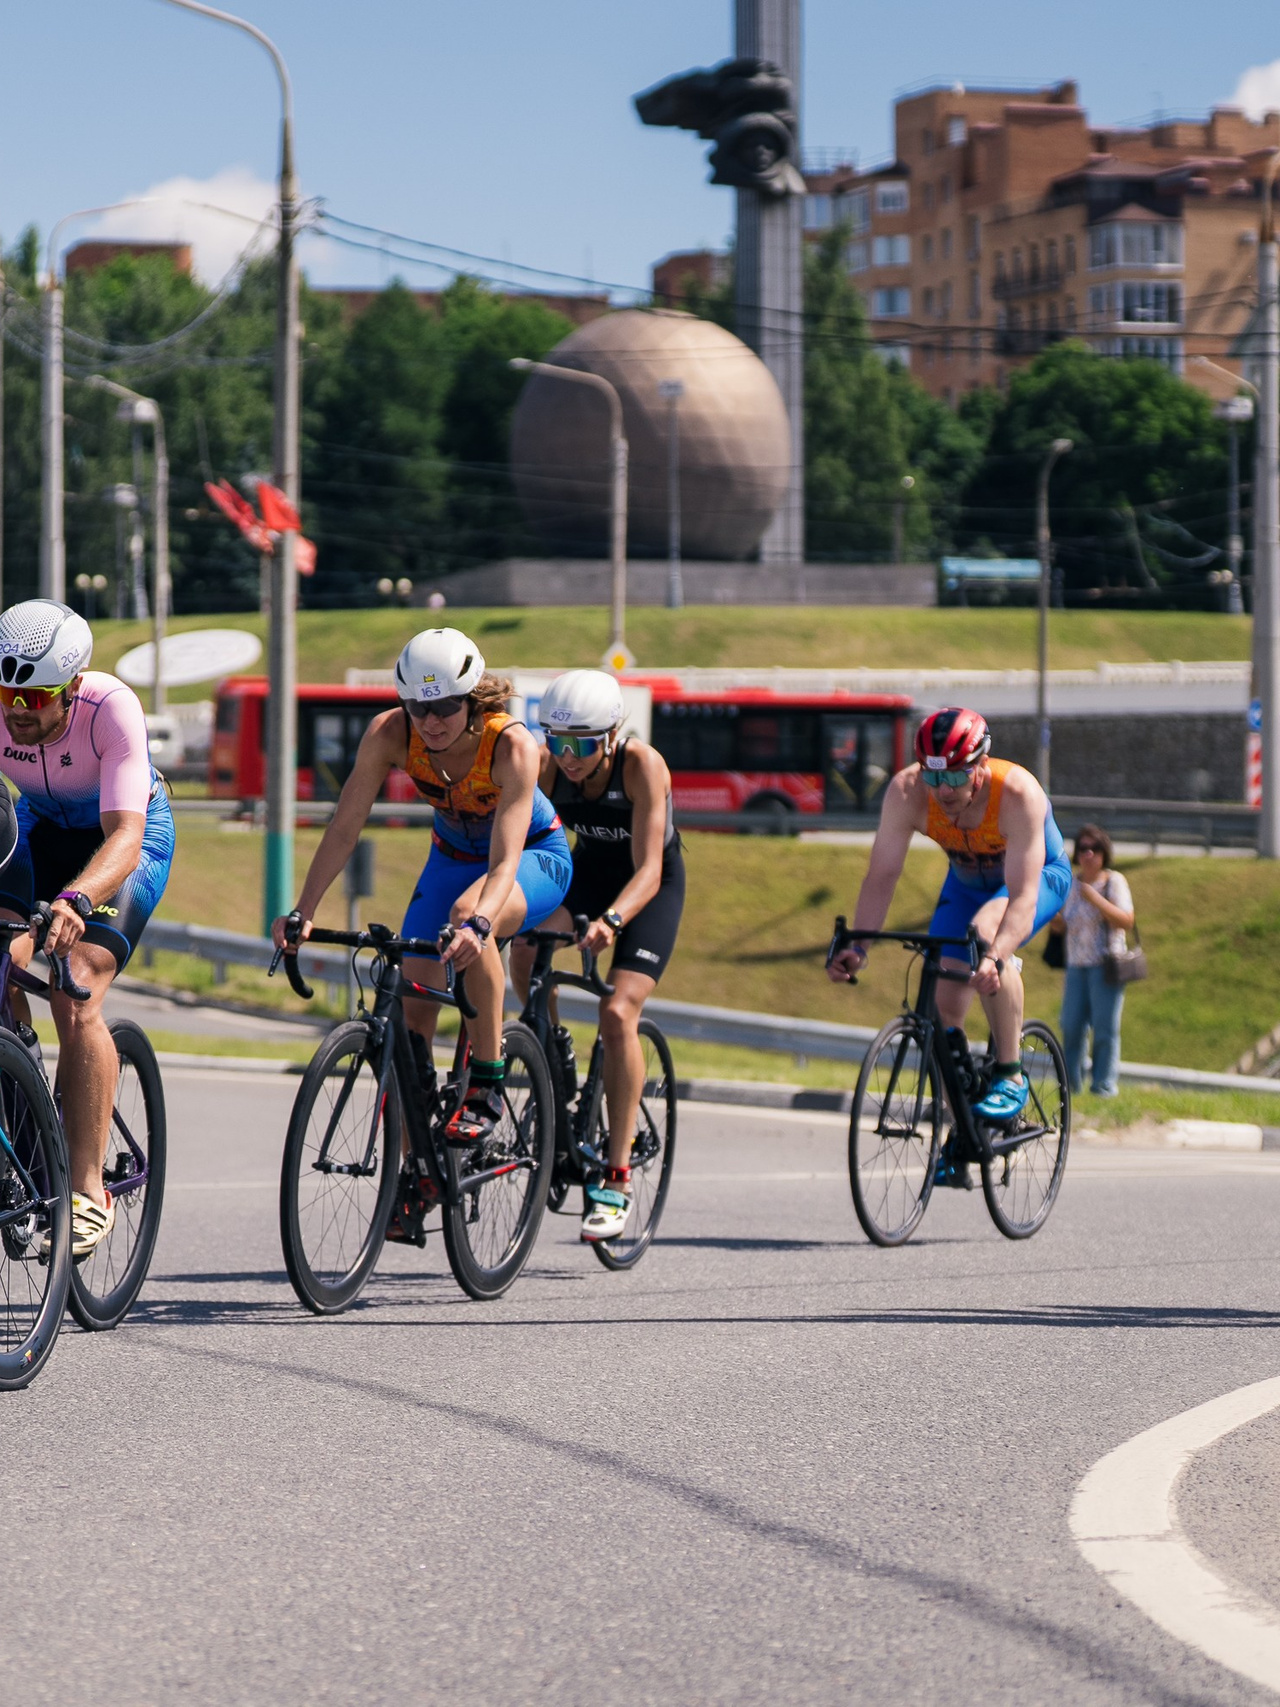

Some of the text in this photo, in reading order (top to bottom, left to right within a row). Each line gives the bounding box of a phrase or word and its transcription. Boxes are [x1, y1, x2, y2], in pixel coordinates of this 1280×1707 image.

[60, 649, 80, 668] 204
[421, 685, 441, 698] 163
[551, 710, 572, 722] 407
[3, 746, 38, 764] DWC
[573, 823, 632, 840] ALIEVA
